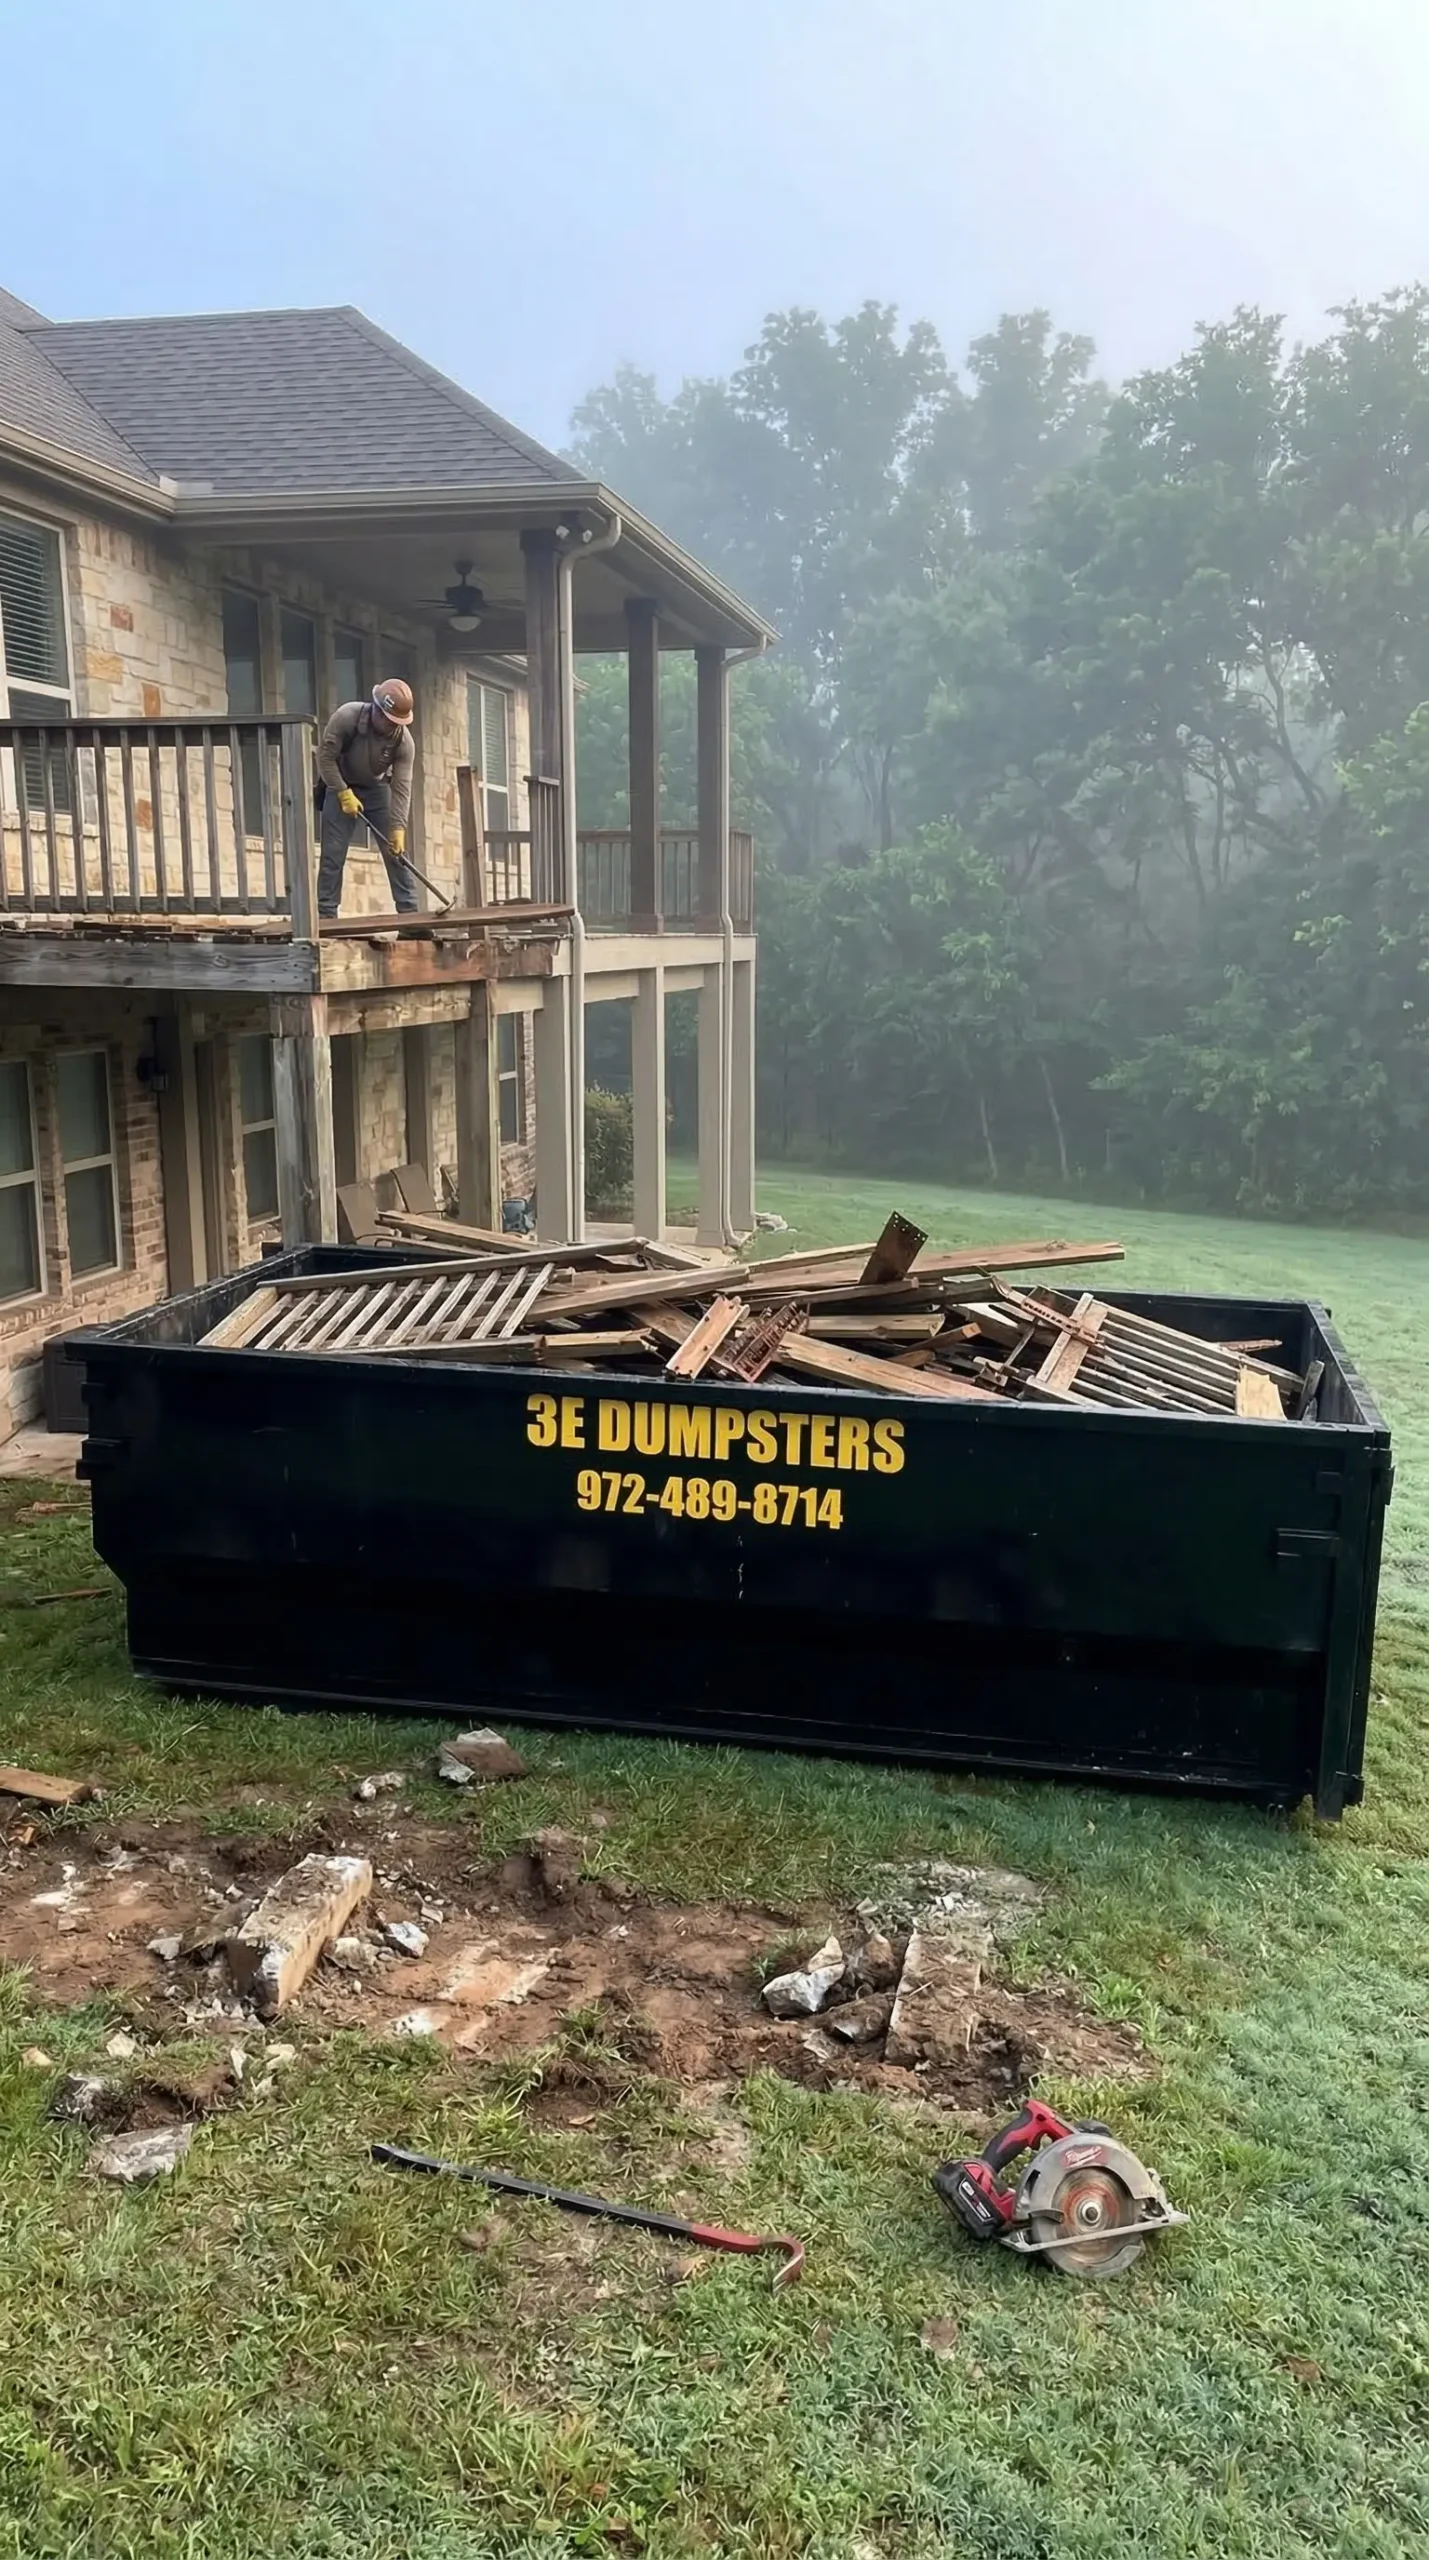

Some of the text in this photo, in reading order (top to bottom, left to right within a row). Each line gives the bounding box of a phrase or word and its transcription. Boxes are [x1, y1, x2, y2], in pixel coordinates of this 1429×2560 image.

[526, 1393, 905, 1474] 3E DUMPSTERS
[576, 1469, 844, 1530] 972-489-8714
